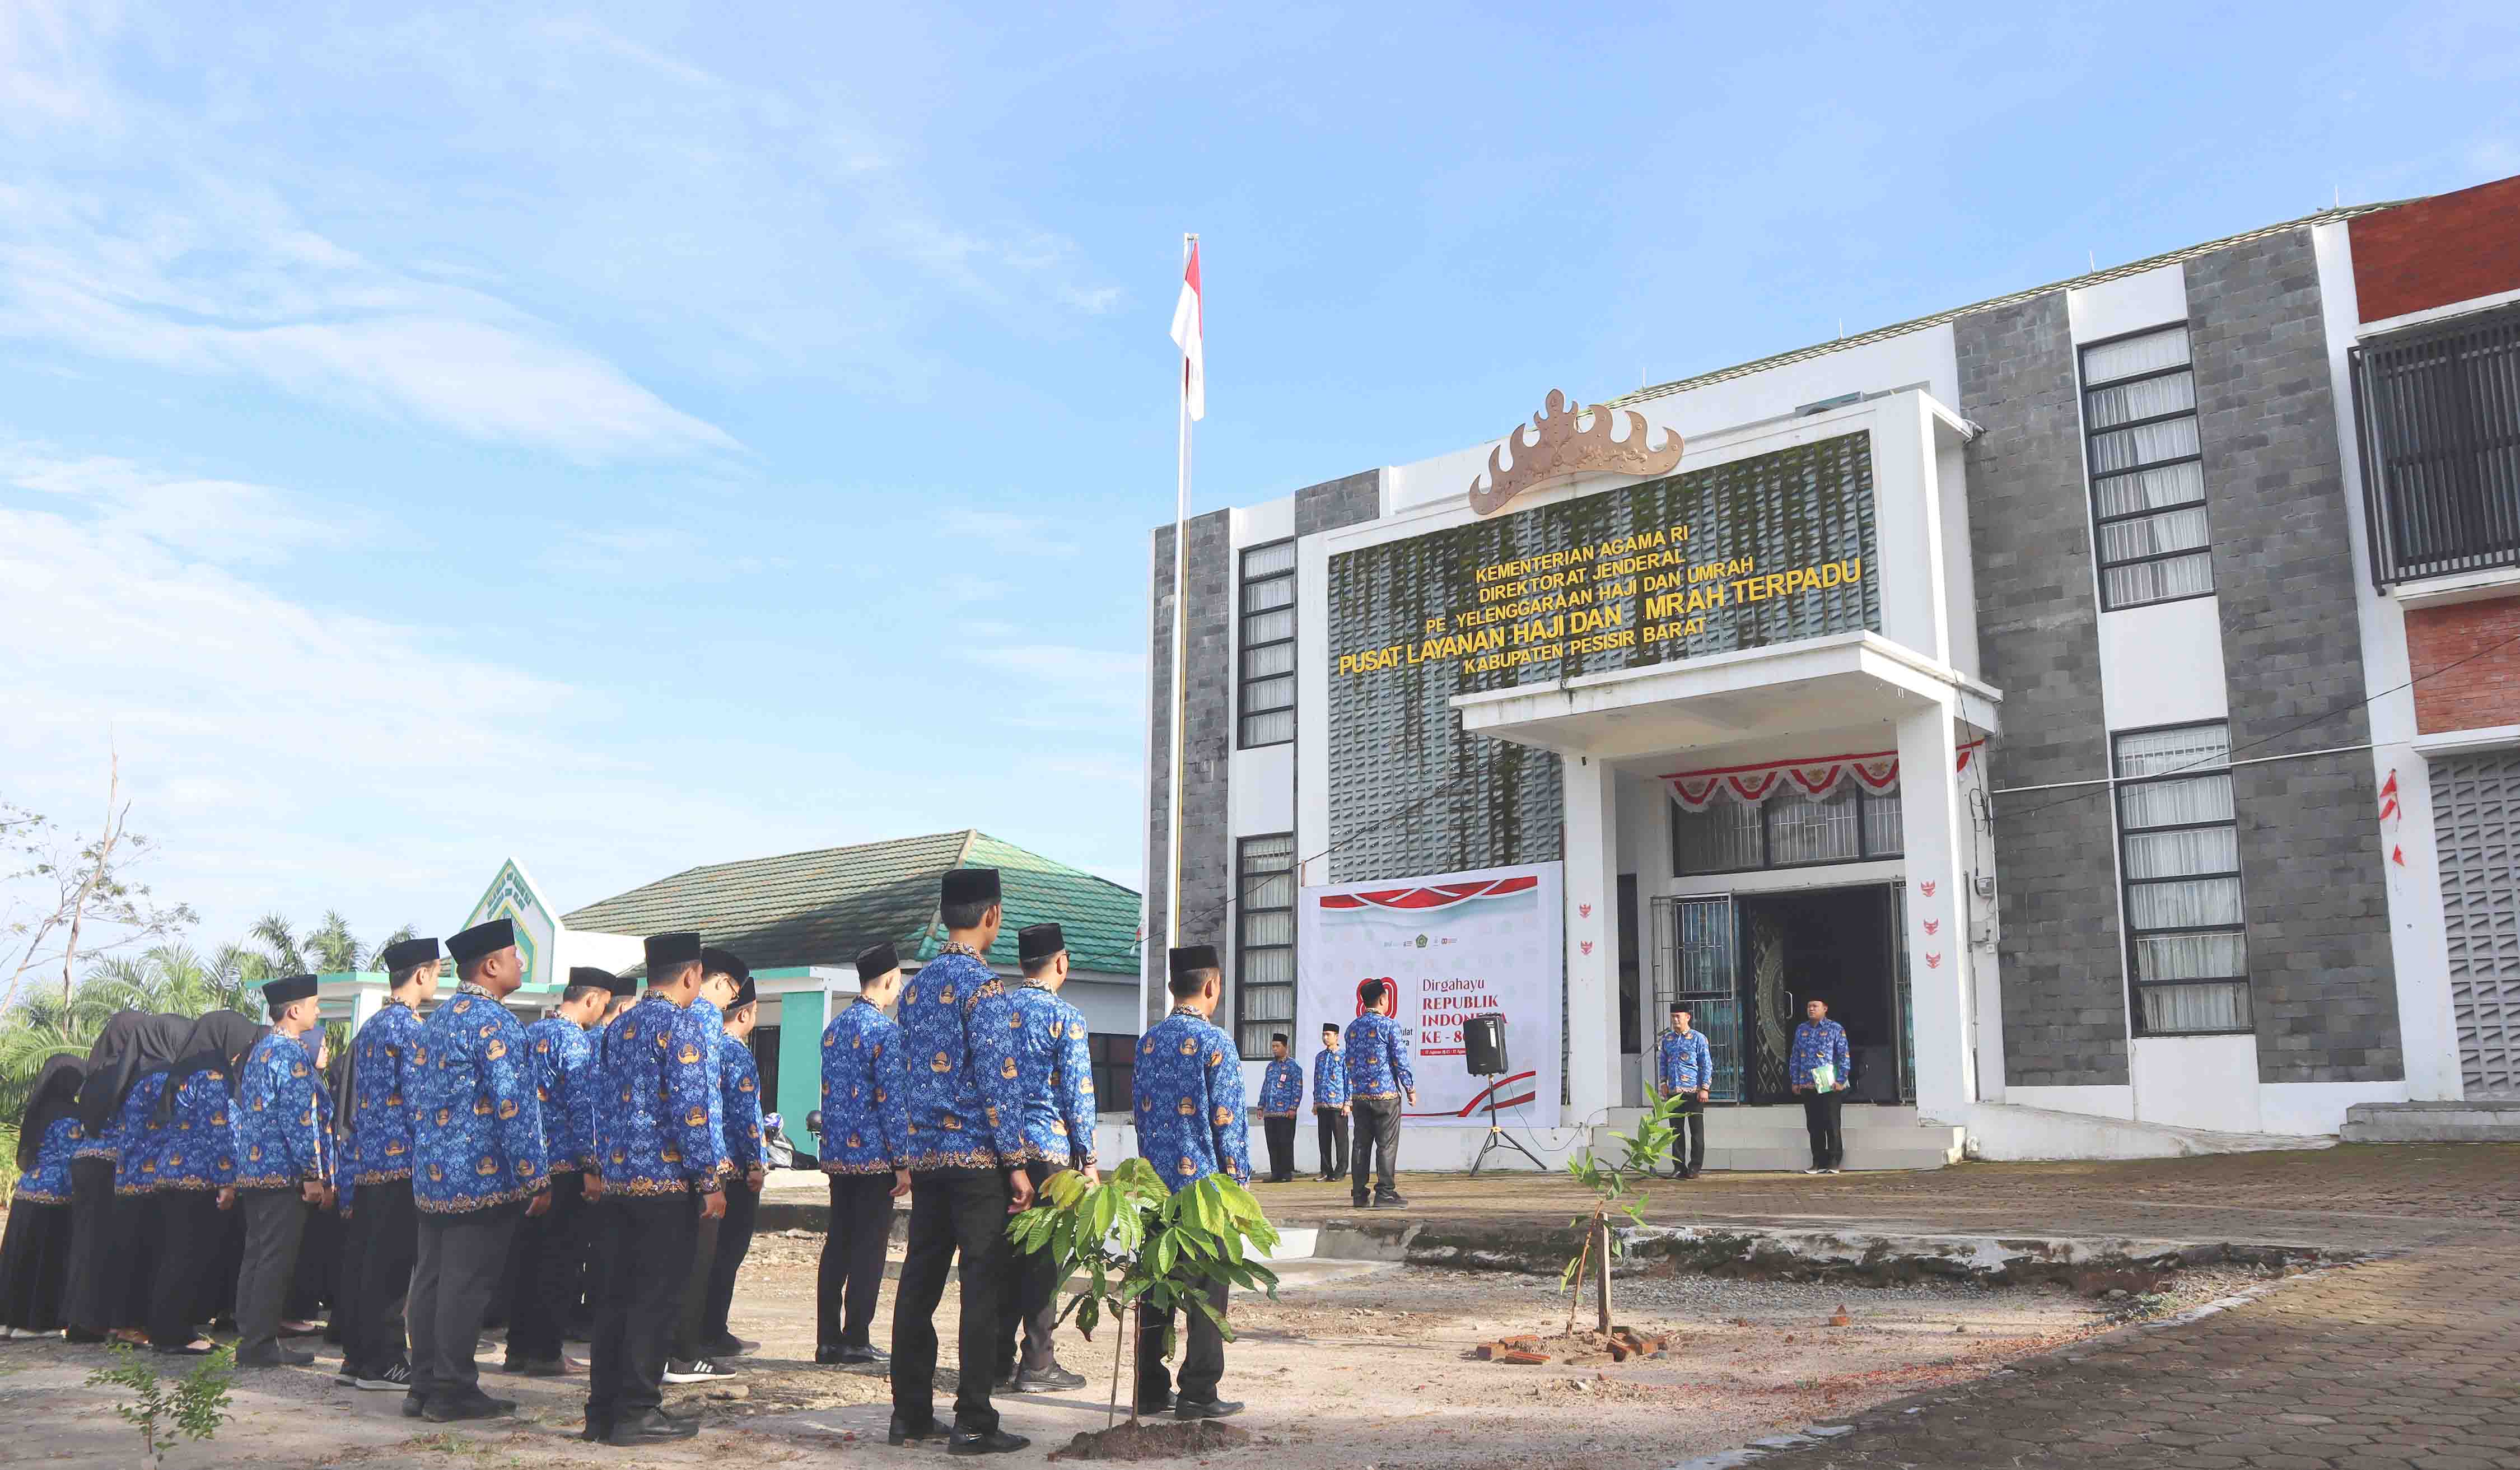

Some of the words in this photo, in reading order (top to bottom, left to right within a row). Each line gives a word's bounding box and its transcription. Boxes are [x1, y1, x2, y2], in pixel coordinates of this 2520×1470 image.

[1476, 545, 1594, 584] KEMENTERIAN
[1600, 530, 1666, 558] AGAMA
[1670, 525, 1688, 543] RI
[1479, 567, 1587, 603] DIREKTORAT
[1593, 549, 1686, 581] JENDERAL
[1599, 579, 1637, 601] HAJI
[1644, 571, 1681, 592] DAN
[1687, 556, 1754, 583] UMRAH
[1340, 645, 1403, 676] PUSAT
[1407, 626, 1505, 664] LAYANAN
[1514, 615, 1564, 645] HAJI
[1570, 604, 1622, 634] DAN
[1645, 584, 1725, 620] MRAH
[1731, 558, 1861, 604] TERPADU
[1465, 644, 1564, 674] KABUPATEN
[1570, 630, 1635, 655] PESISIR
[1643, 617, 1706, 643] BARAT
[1423, 978, 1485, 992] Dirgahayu
[1423, 995, 1499, 1010] REPUBLIK
[1422, 1012, 1508, 1026] INDONA
[1422, 1030, 1441, 1044] KE
[1453, 1030, 1465, 1043] 8
